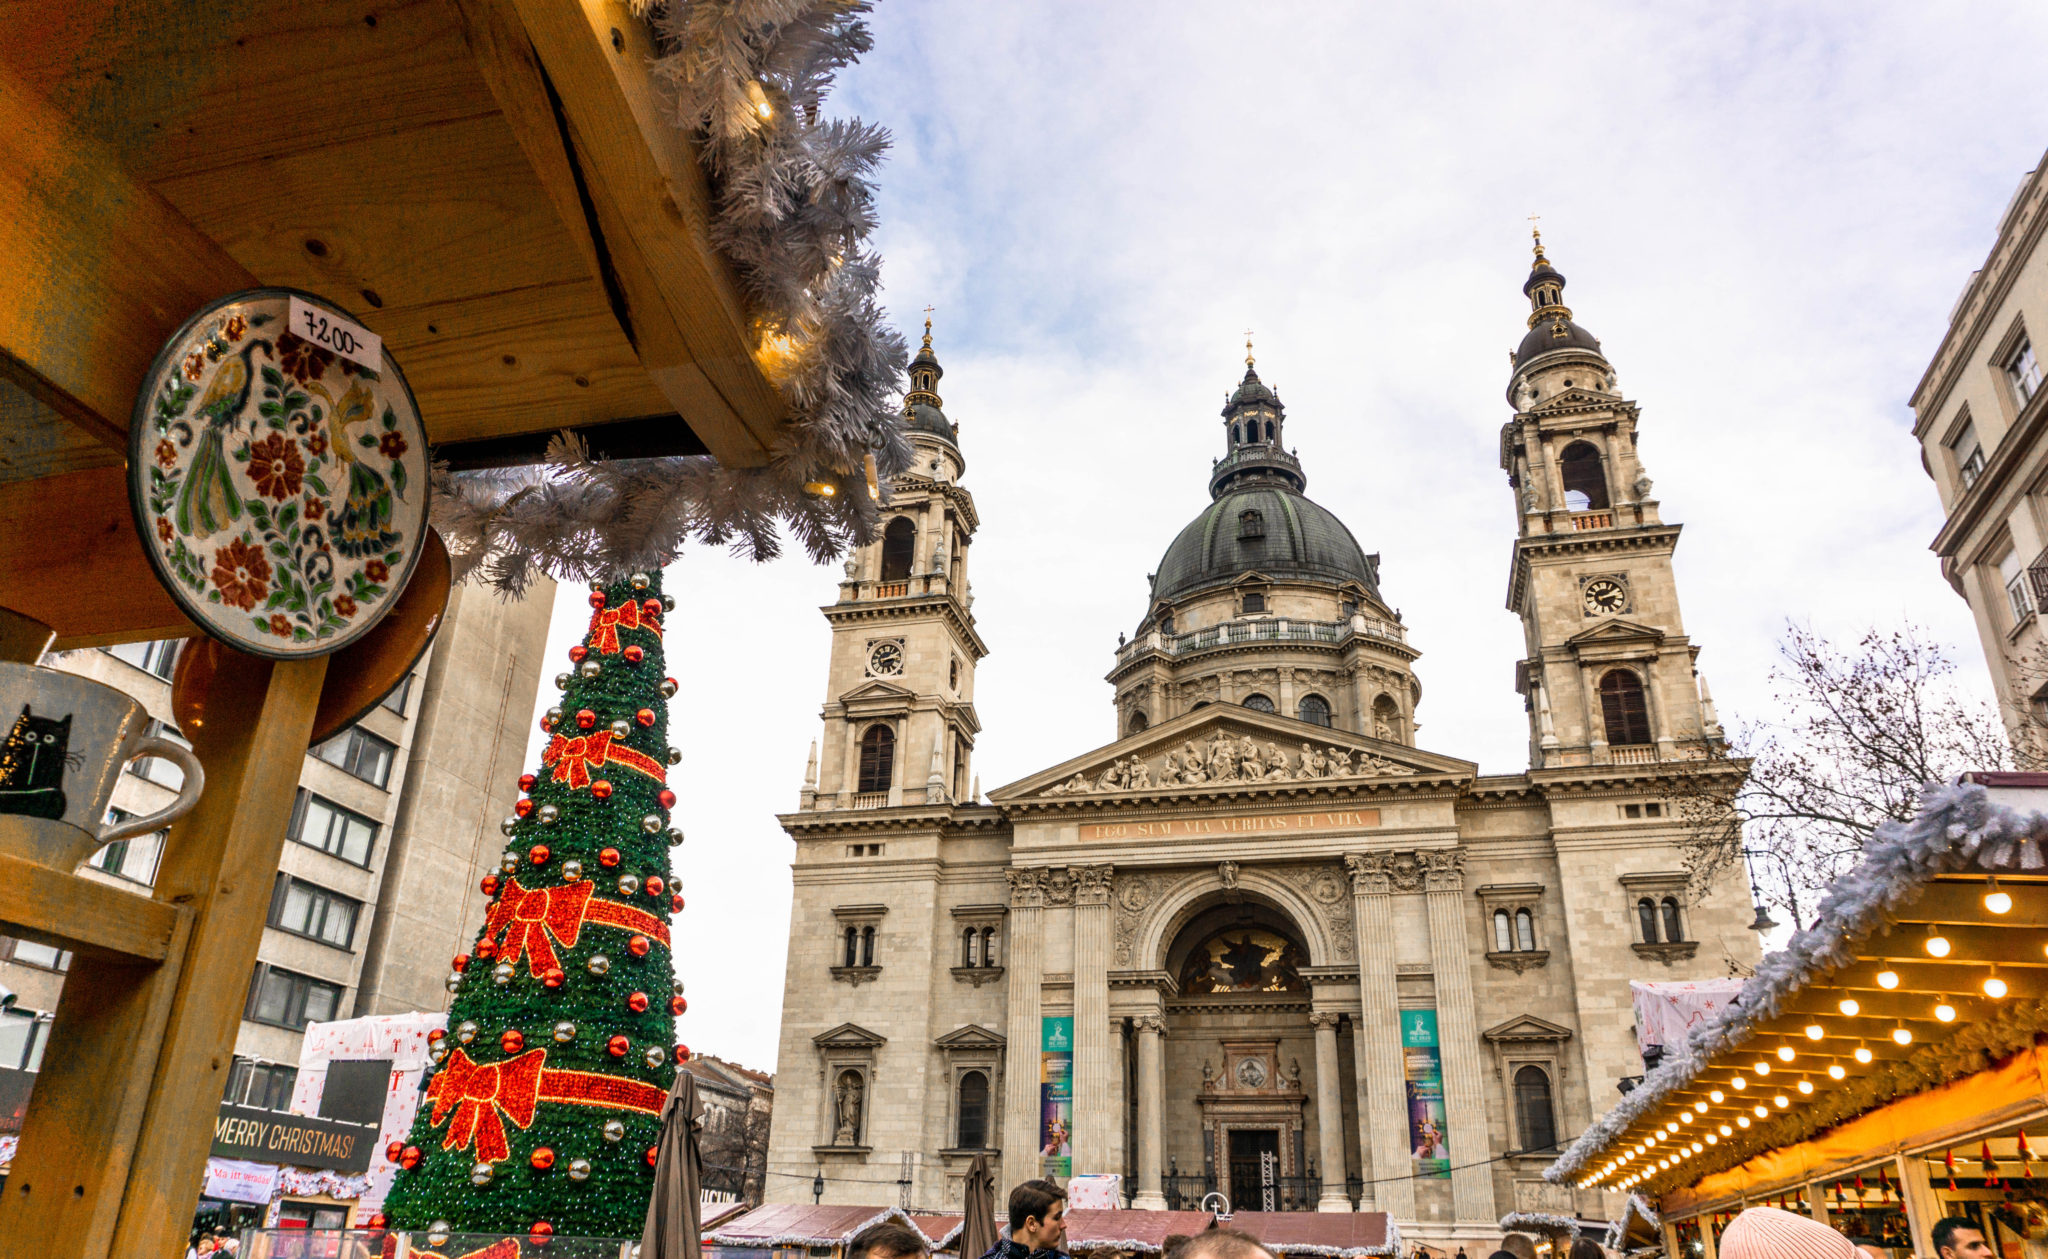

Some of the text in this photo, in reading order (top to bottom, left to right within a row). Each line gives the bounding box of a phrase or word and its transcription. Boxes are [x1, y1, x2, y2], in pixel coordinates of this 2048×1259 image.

[304, 310, 363, 354] 7200-
[1096, 812, 1363, 838] EGO SUM VIA VERITAS ET VITA
[214, 1116, 356, 1159] MERRY CHRISTMAS!
